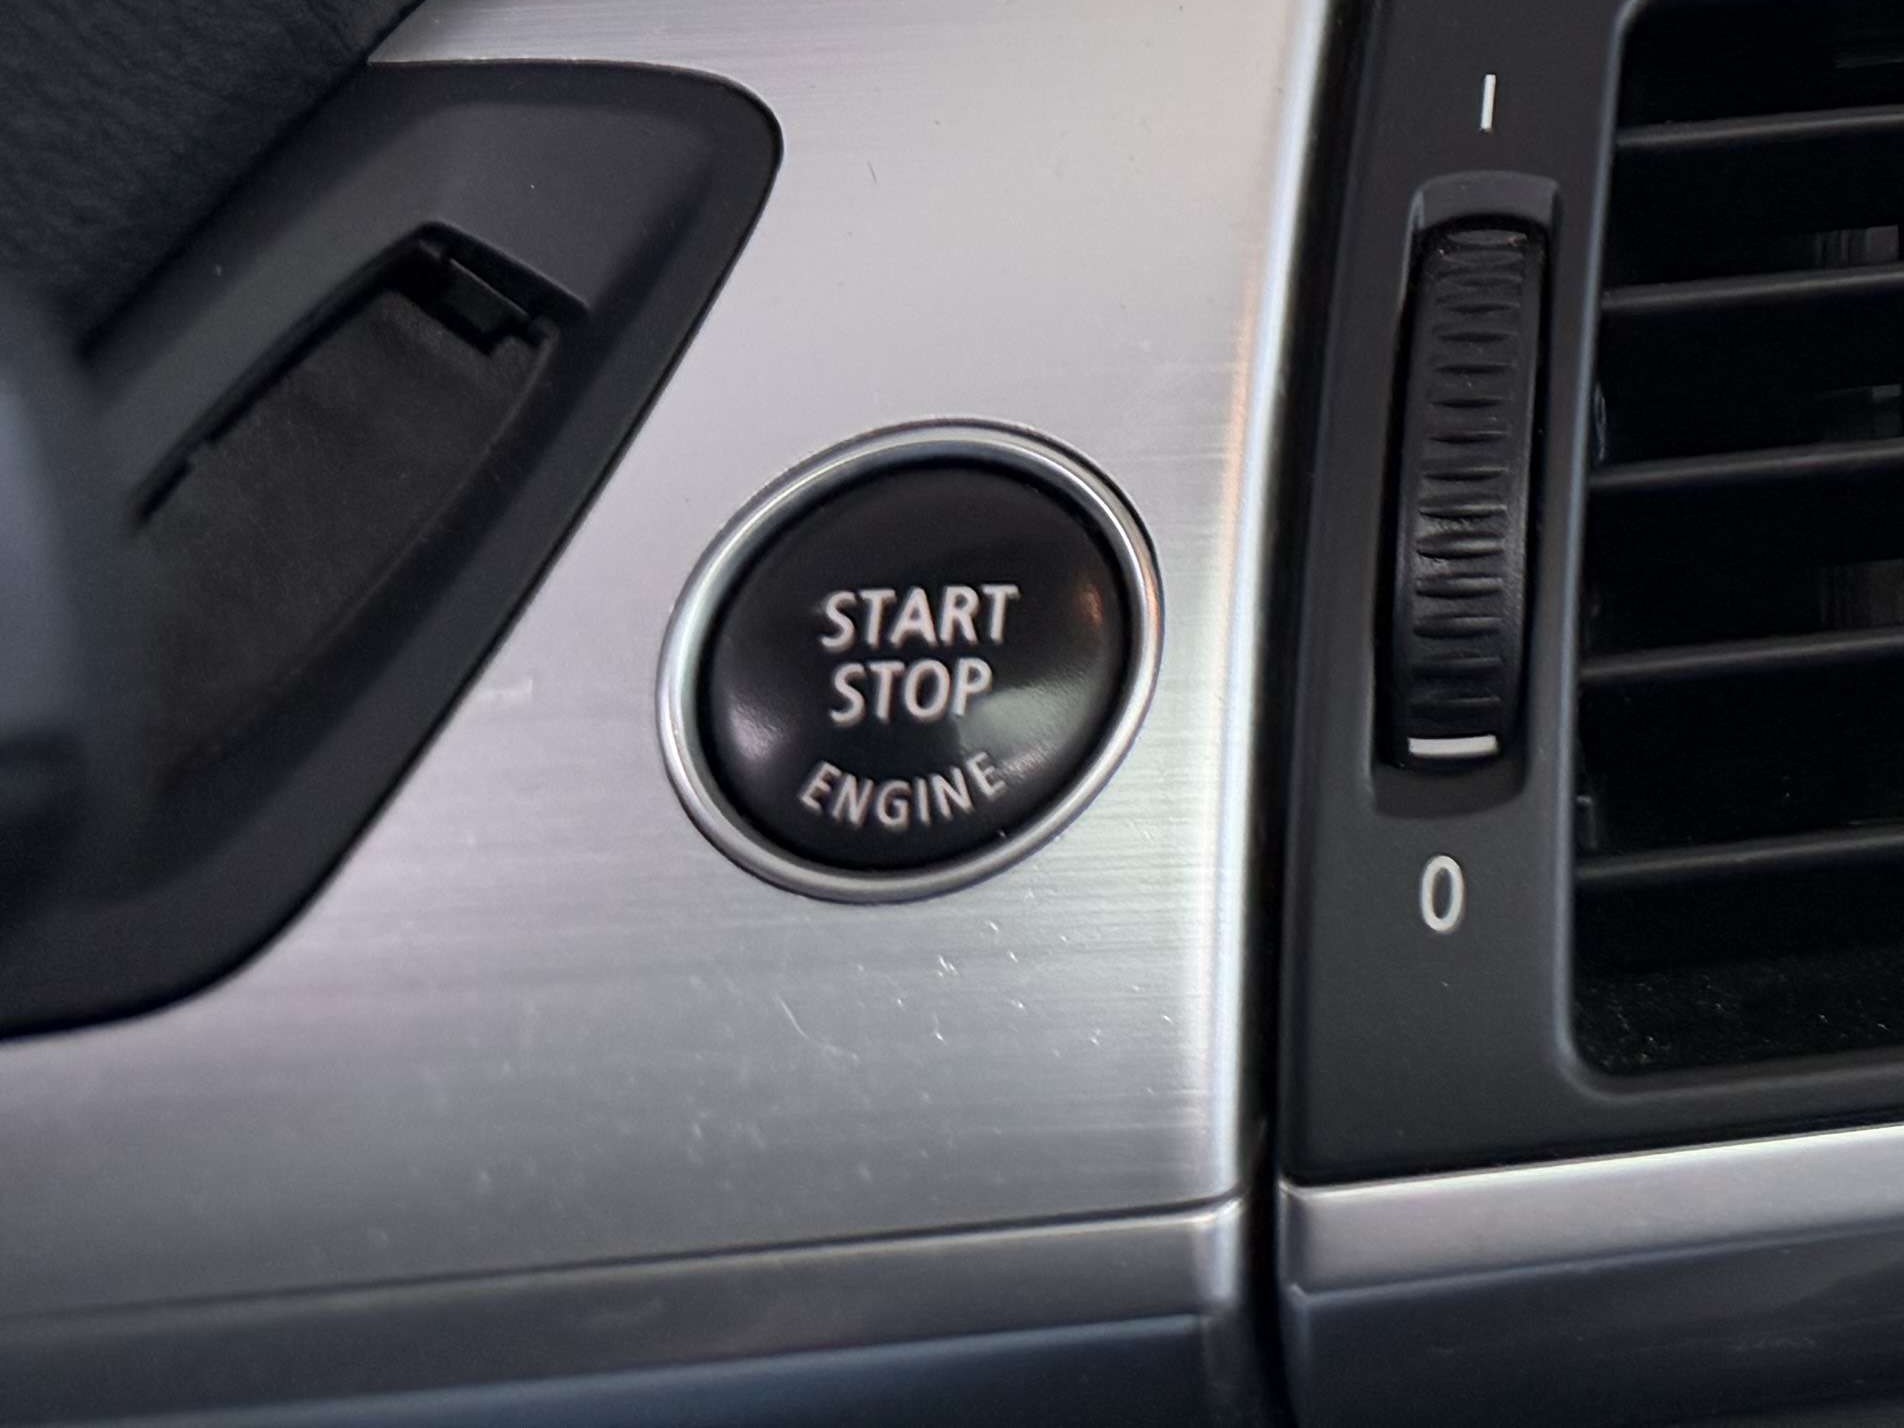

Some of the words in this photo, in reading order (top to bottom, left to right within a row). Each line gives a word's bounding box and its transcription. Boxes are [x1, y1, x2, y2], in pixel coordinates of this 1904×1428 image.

[819, 584, 1018, 652] START
[831, 657, 992, 728] STOP
[799, 751, 1007, 829] ENGINE
